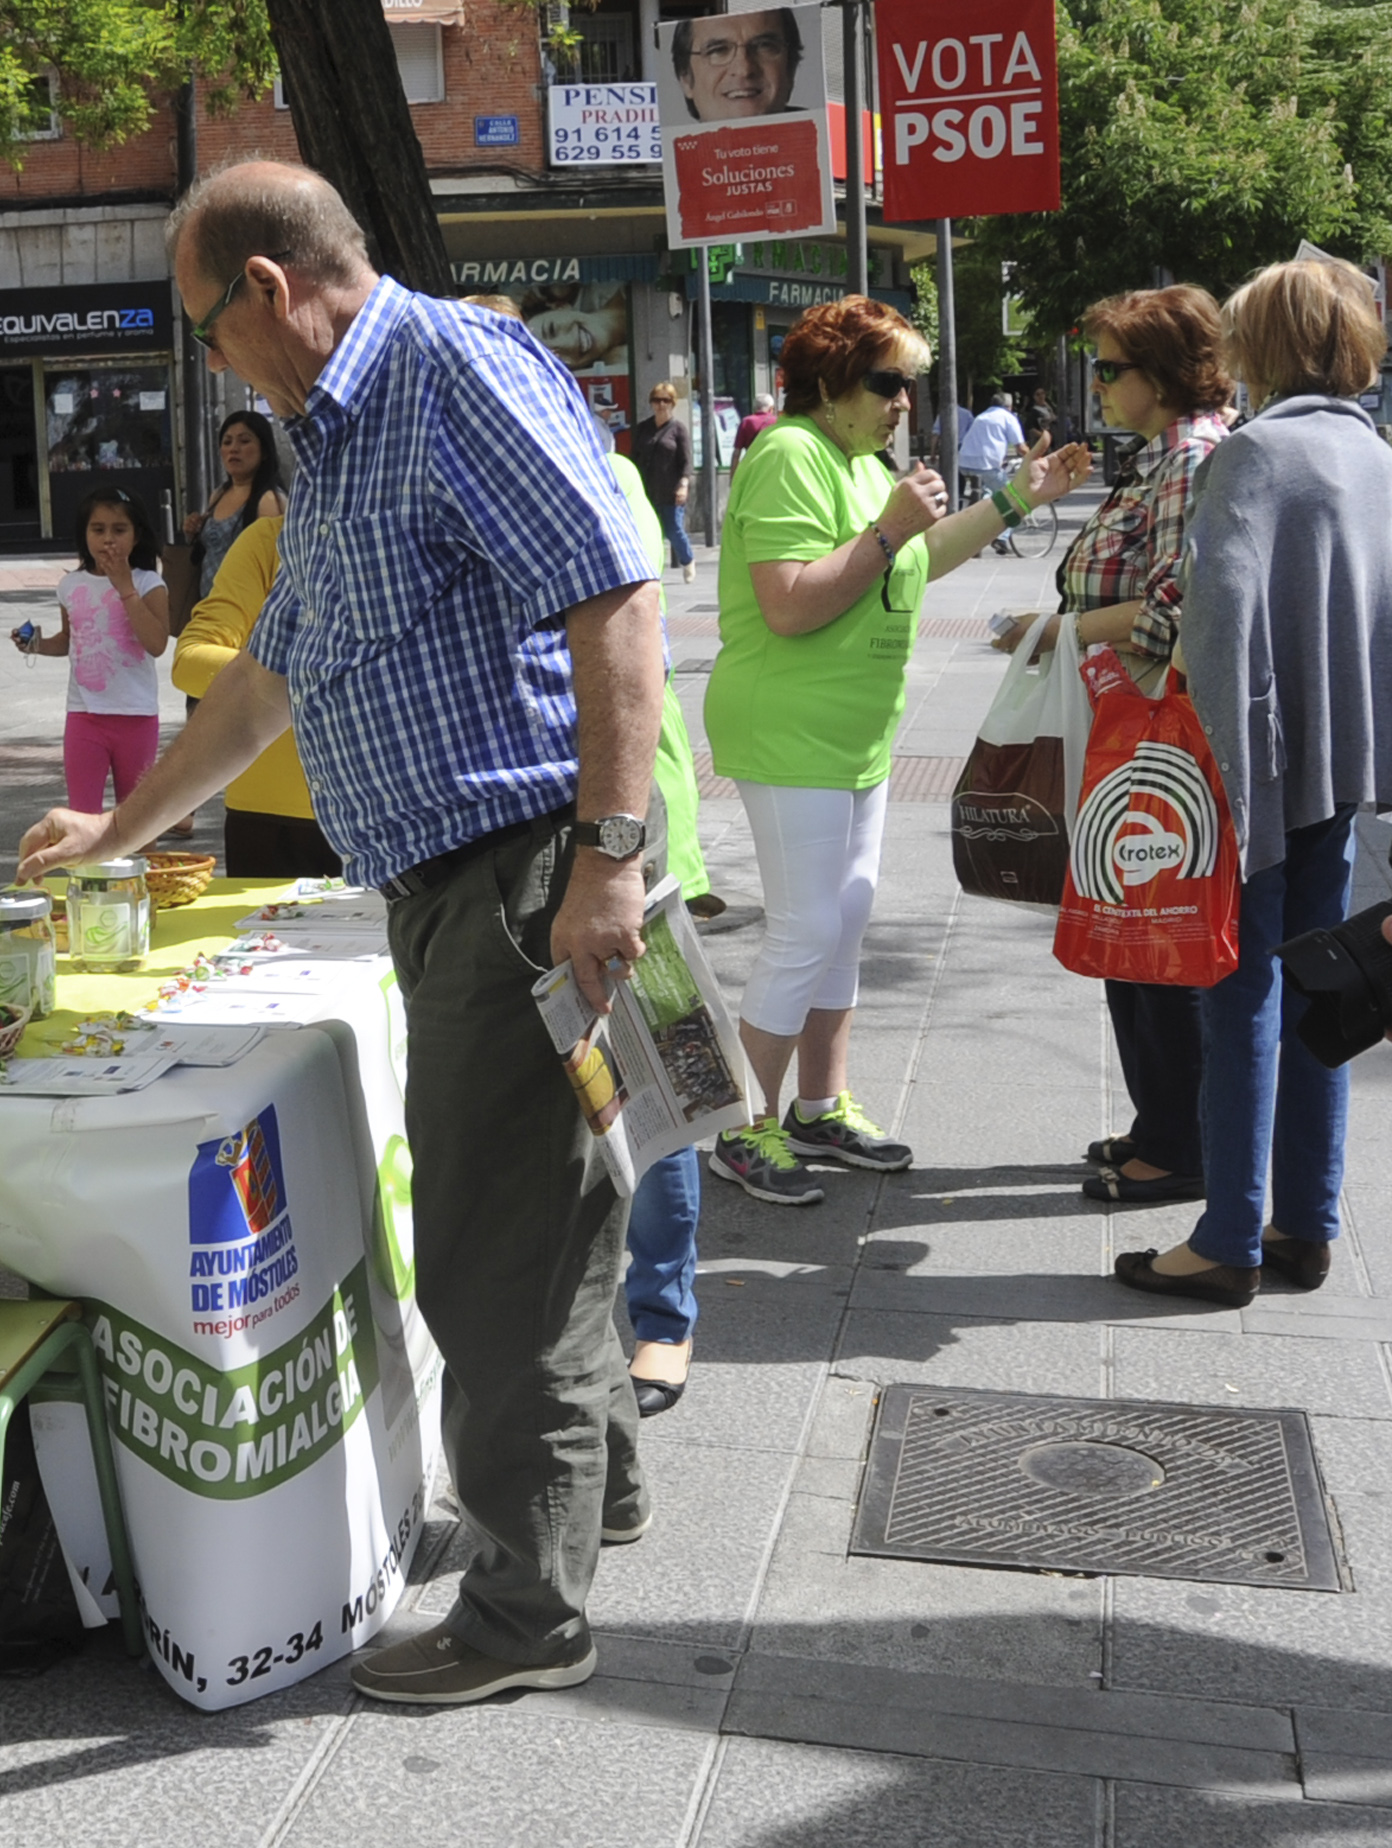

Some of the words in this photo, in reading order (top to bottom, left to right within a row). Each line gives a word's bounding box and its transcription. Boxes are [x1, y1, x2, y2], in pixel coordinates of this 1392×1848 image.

[892, 31, 1042, 93] VOTA
[555, 128, 582, 143] 91
[595, 127, 640, 142] 614
[555, 146, 601, 161] 629
[611, 145, 641, 160] 55
[714, 148, 727, 159] Tu
[729, 147, 752, 158] voto
[753, 144, 779, 155] tiene
[894, 100, 1044, 165] PSOE
[702, 163, 795, 186] Soluciones
[726, 181, 773, 196] JUSTAS
[1118, 843, 1181, 862] Crotex
[189, 1213, 293, 1278] AYUNTAMIENTO
[191, 1282, 224, 1313] DE
[227, 1244, 299, 1310] MÓSTOLES
[193, 1314, 251, 1340] mejor
[251, 1305, 274, 1330] para
[273, 1282, 301, 1313] todos
[91, 1315, 333, 1430] ASOCIACIÓN
[333, 1293, 359, 1357] DE
[101, 1357, 362, 1484] FIBROMIALGIA
[225, 1627, 324, 1686] 32-34
